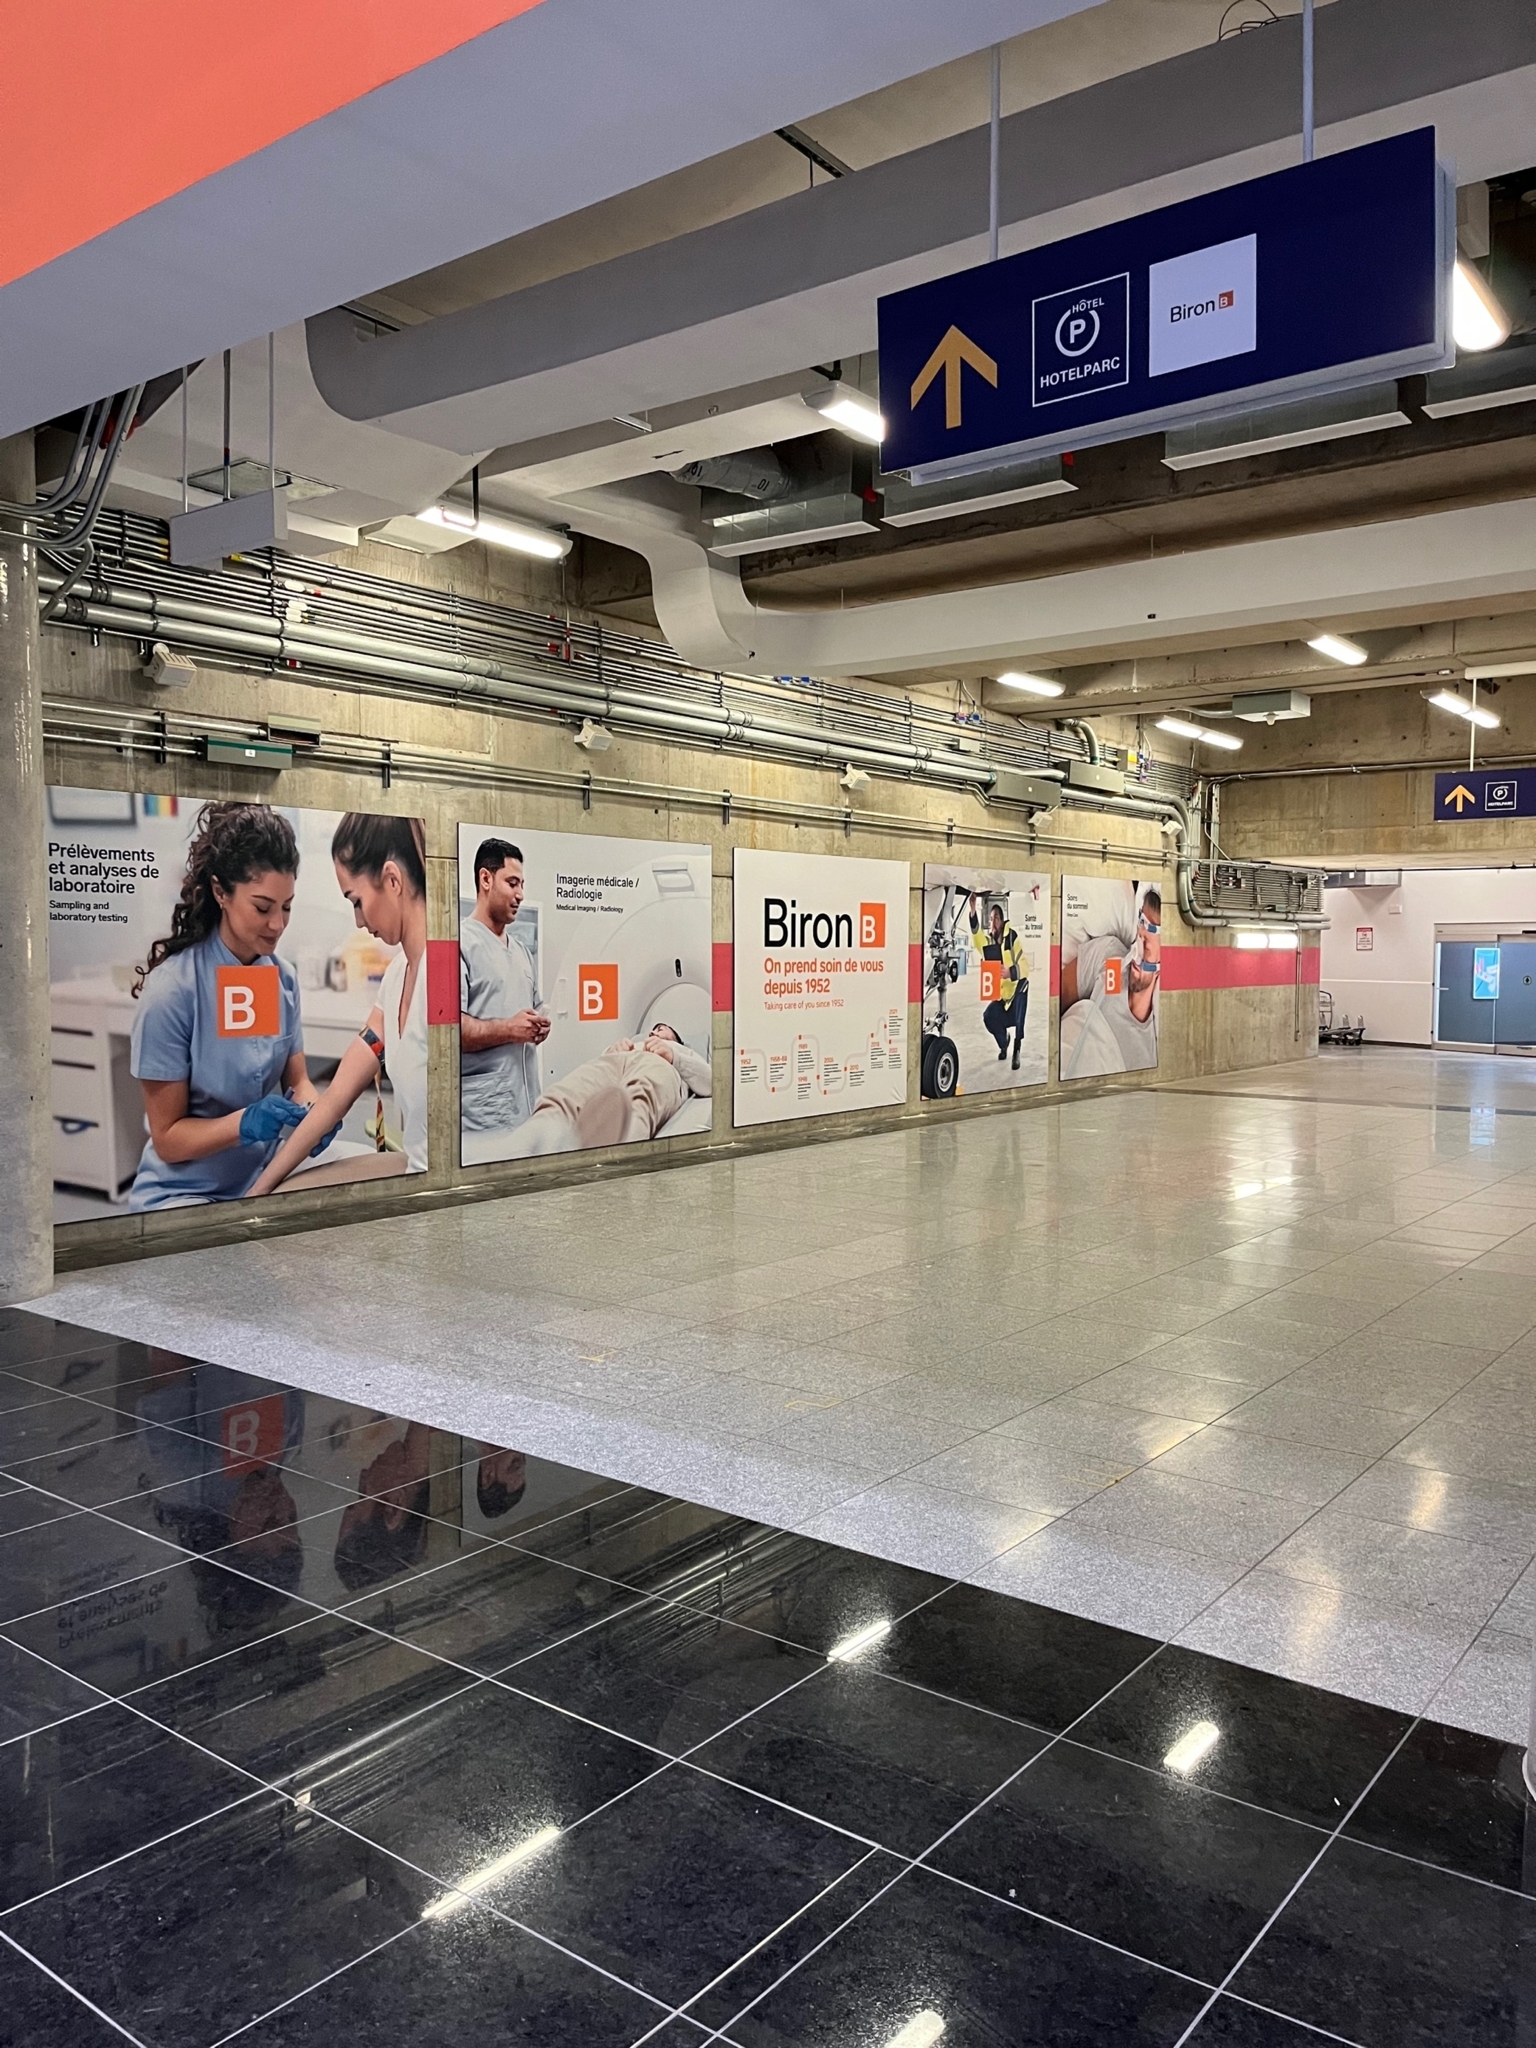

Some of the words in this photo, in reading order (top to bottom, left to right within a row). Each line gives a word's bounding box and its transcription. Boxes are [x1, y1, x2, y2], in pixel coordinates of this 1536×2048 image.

[1072, 297, 1105, 314] HÔTEL
[1170, 300, 1215, 323] Biron
[1220, 296, 1228, 307] B
[1069, 318, 1086, 344] P
[1040, 356, 1120, 389] HOTELPARC
[48, 842, 155, 862] Prélèvements
[48, 861, 66, 875] et
[69, 862, 137, 879] analyses
[140, 865, 159, 879] de
[49, 877, 135, 894] laboratoire
[556, 873, 595, 887] Imagerie
[596, 876, 634, 888] médicale
[556, 887, 603, 901] Radiologie
[49, 900, 91, 911] Sampling
[93, 902, 109, 910] and
[577, 905, 596, 913] Imaging
[600, 906, 624, 914] Radiology
[49, 912, 96, 923] laboratory
[98, 914, 128, 923] testing
[764, 897, 853, 949] Biron
[861, 915, 876, 943] B
[764, 957, 781, 974] On
[784, 957, 817, 977] prend
[819, 957, 842, 973] soin
[844, 957, 858, 972] de
[859, 960, 884, 972] vous
[764, 978, 803, 998] depuis
[805, 978, 831, 993] 1952
[982, 971, 993, 997] B
[1107, 969, 1115, 991] B
[223, 985, 256, 1030] B
[583, 980, 604, 1015] B
[764, 1001, 783, 1011] Taking
[784, 1001, 796, 1010] care
[797, 1000, 804, 1009] of
[804, 1002, 815, 1010] you
[815, 1000, 830, 1008] since
[831, 999, 844, 1007] 1952
